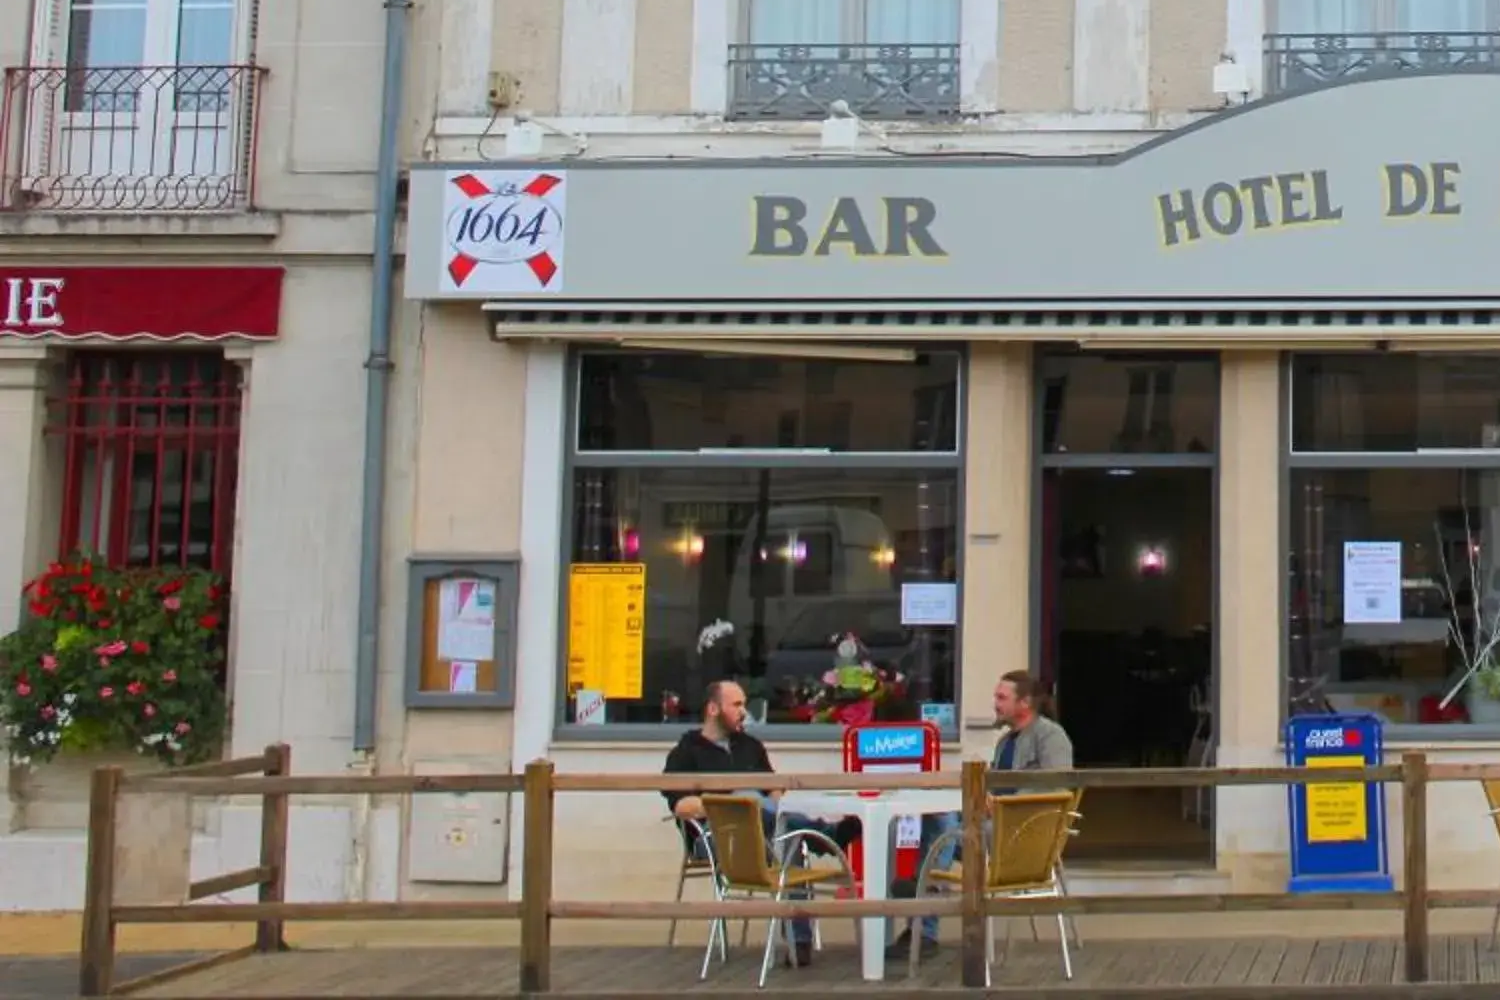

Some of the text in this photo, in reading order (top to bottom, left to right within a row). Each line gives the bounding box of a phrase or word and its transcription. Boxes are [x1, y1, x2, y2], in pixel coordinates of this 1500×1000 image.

[455, 200, 548, 247] 1664
[747, 195, 951, 260] BAR
[1158, 168, 1343, 247] HOTEL
[1384, 161, 1462, 219] DE
